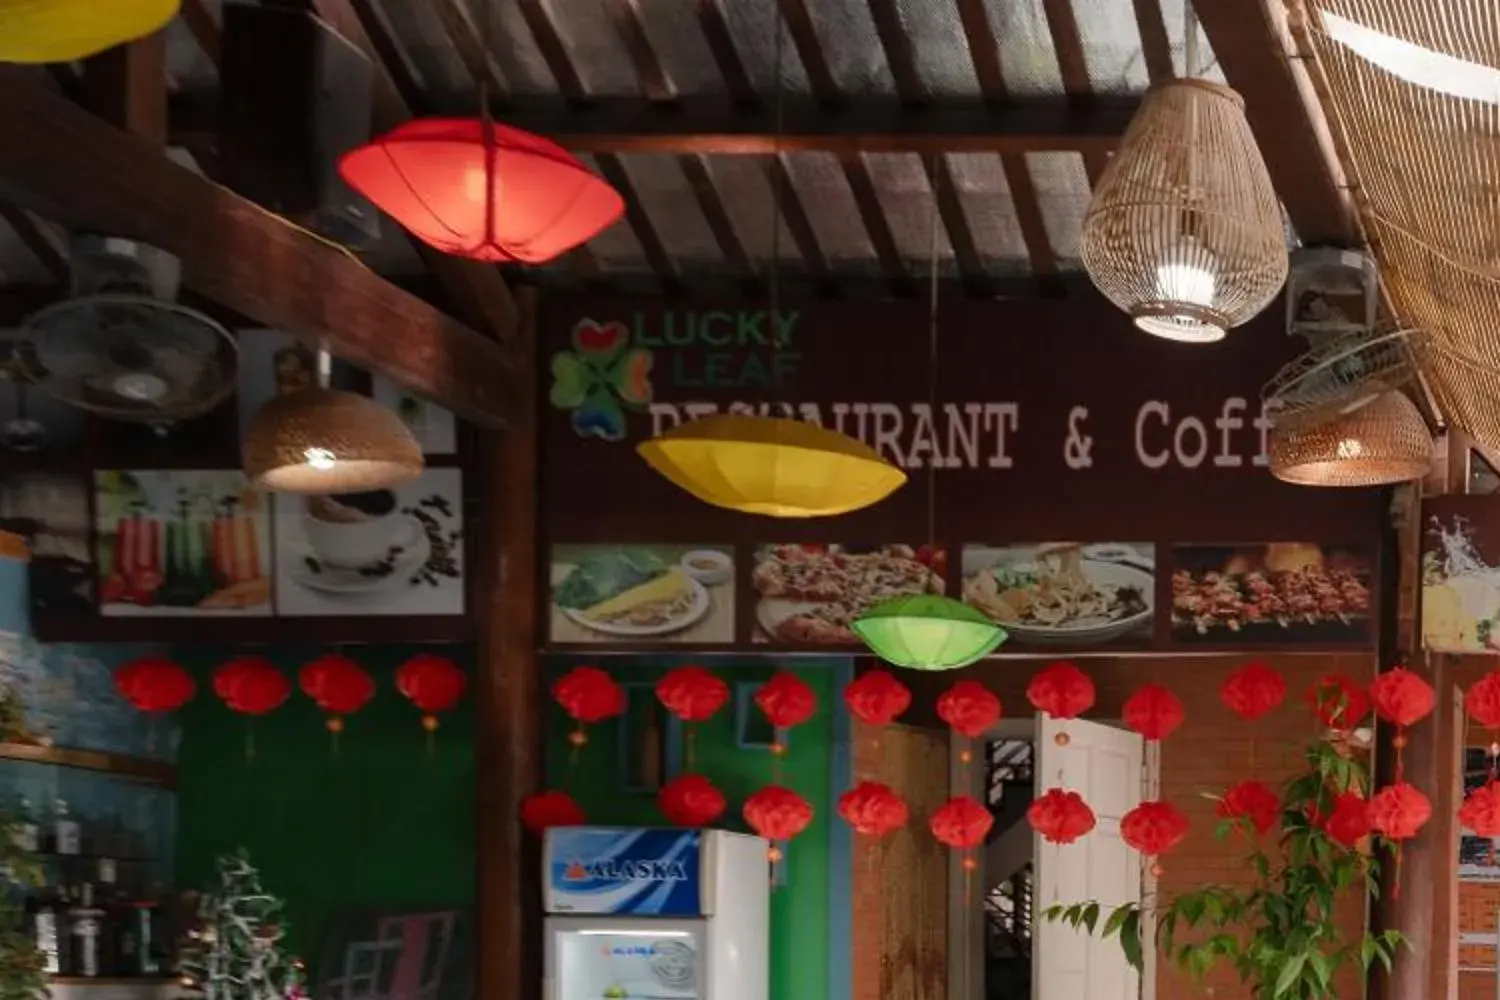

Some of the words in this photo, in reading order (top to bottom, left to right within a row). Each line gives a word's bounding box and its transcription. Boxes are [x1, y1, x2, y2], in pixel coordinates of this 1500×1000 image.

[633, 310, 800, 347] LUCKY
[674, 353, 801, 387] LEAF
[1063, 406, 1094, 469] &
[1134, 397, 1284, 469] Coff
